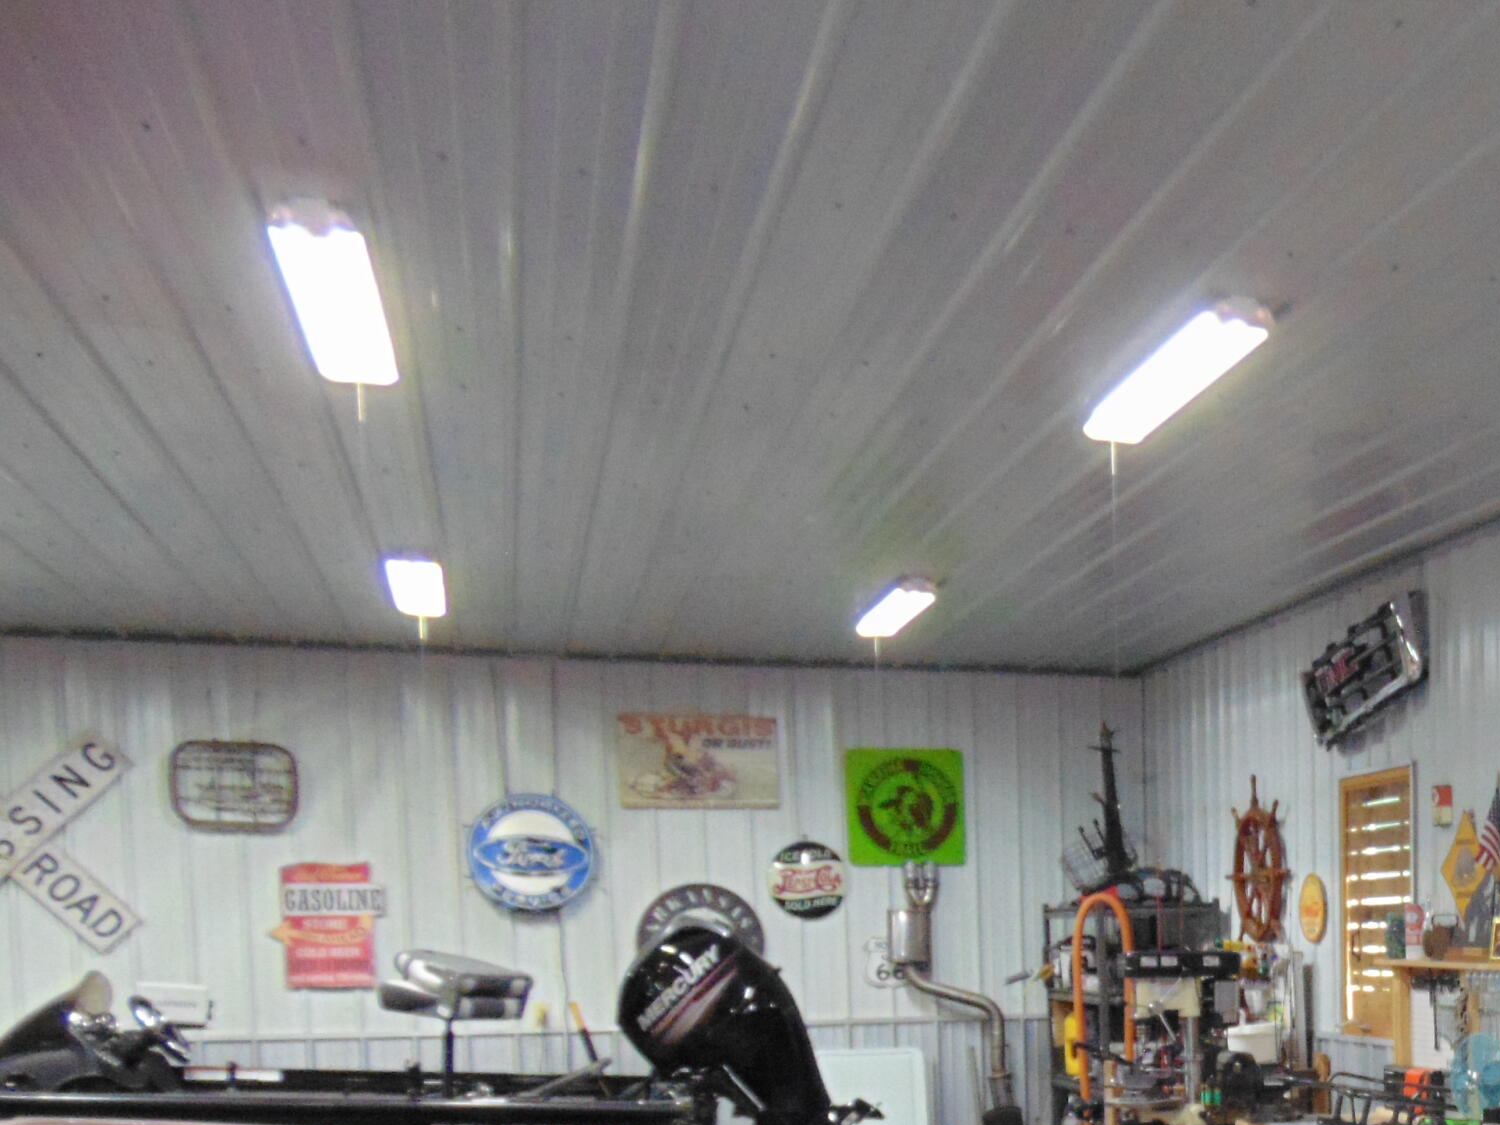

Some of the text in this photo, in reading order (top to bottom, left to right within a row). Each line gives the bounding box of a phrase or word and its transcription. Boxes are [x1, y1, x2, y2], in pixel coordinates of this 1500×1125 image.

[496, 840, 566, 868] Ford
[22, 852, 123, 938] ROAD
[283, 887, 382, 912] GASOLINE
[637, 943, 720, 1032] MERCURY
